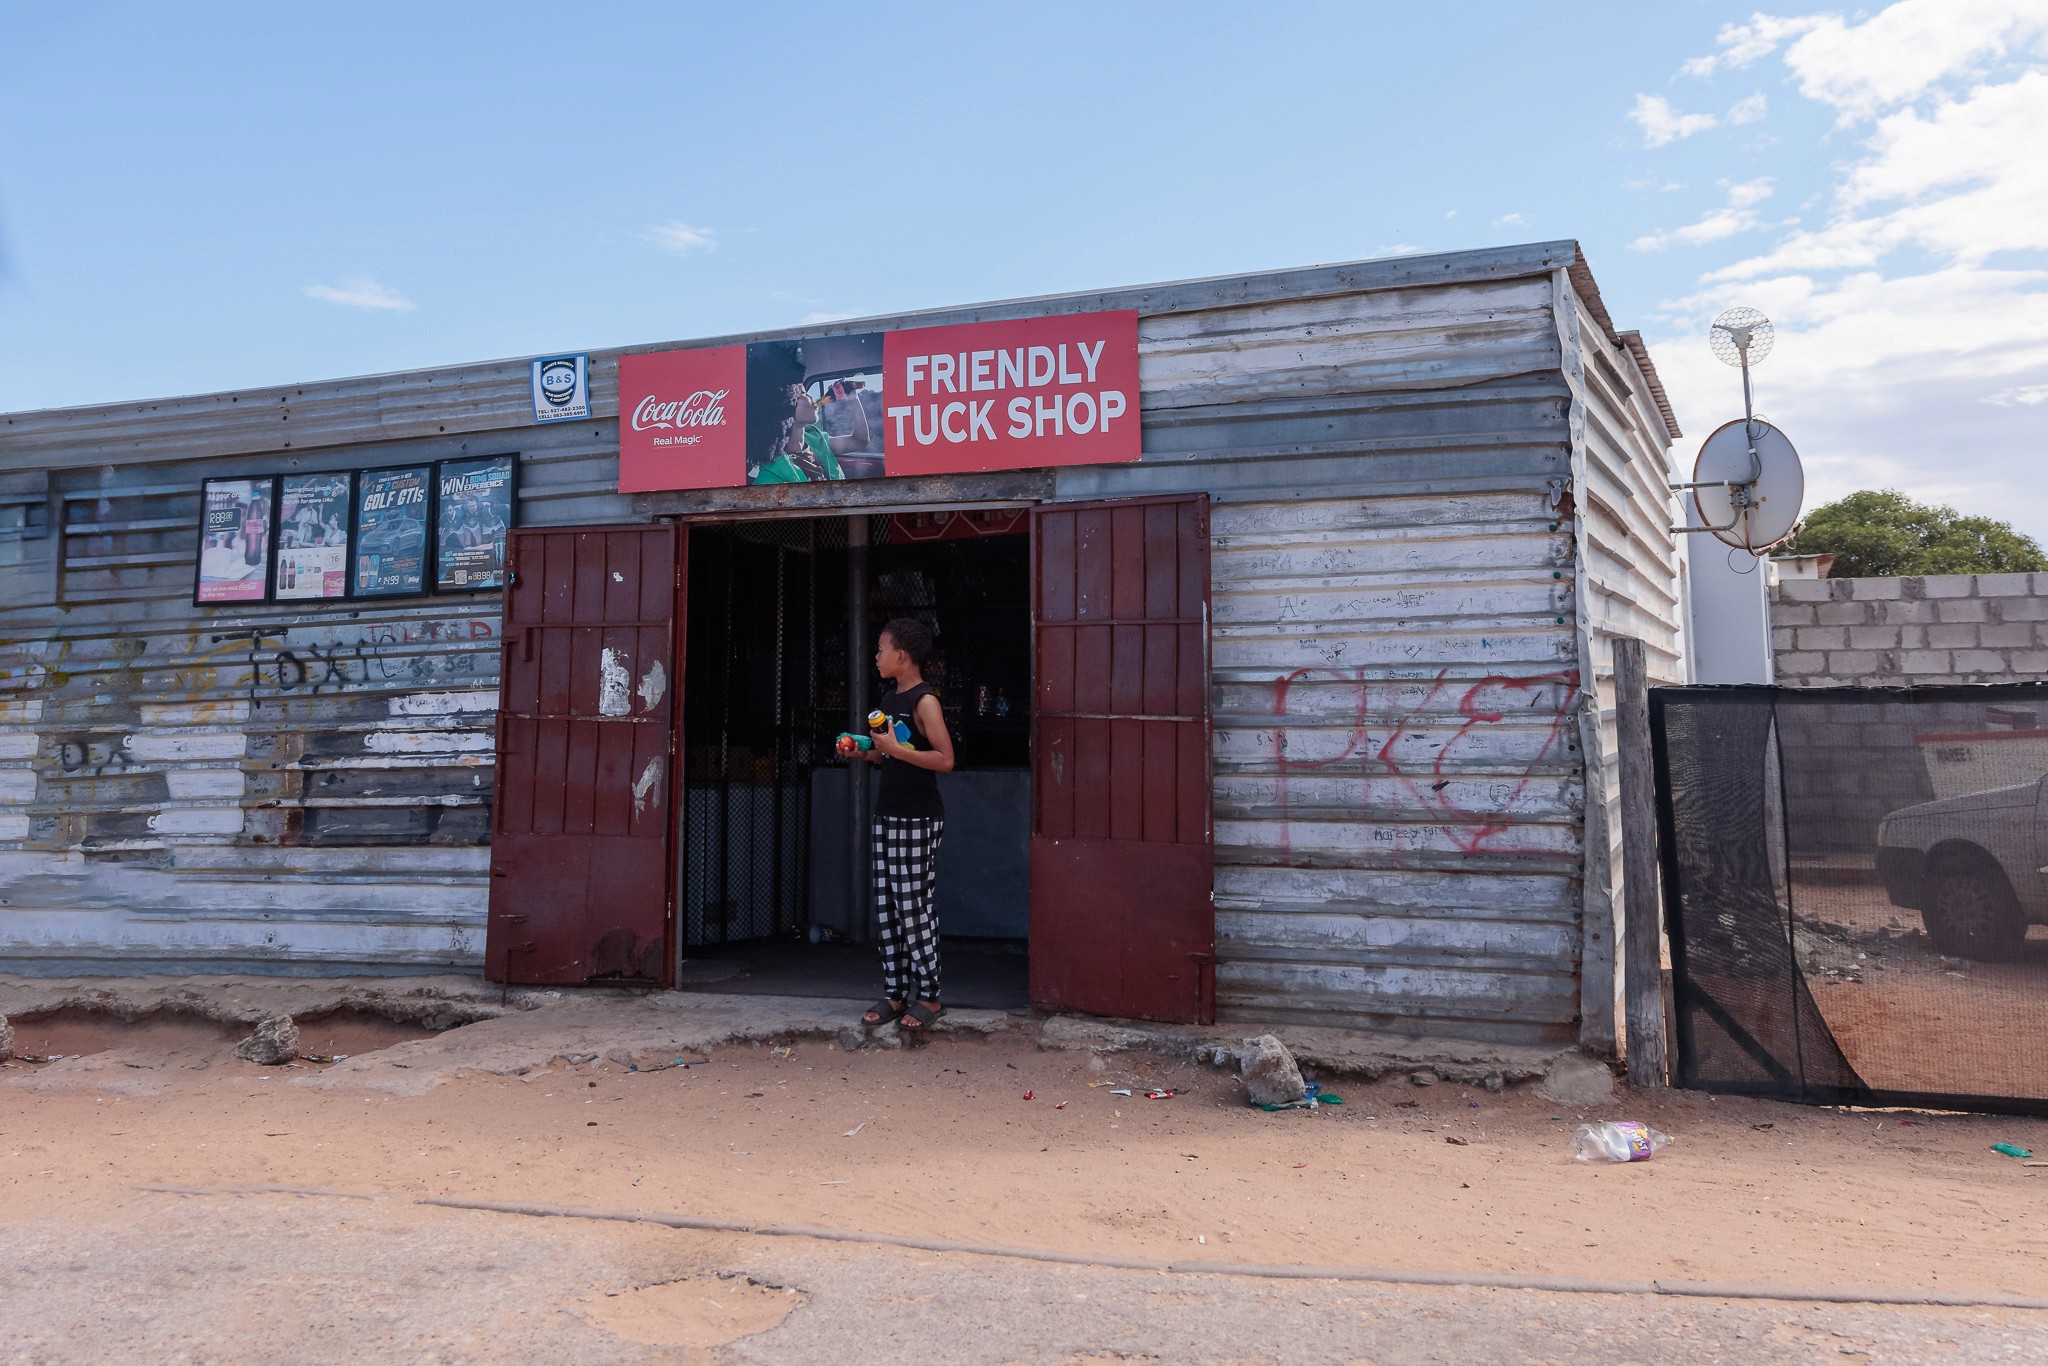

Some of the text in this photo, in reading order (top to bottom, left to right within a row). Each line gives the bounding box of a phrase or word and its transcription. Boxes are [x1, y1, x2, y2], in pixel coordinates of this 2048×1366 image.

[543, 361, 557, 372] PRIVATE
[906, 340, 1106, 397] FRIENDLY
[546, 374, 572, 386] B & S
[631, 388, 730, 432] Coca-Cola
[888, 390, 1127, 447] TUCK SHOP
[653, 434, 701, 446] Real Magic
[487, 471, 510, 481] SQUAD
[376, 483, 385, 492] OF
[384, 481, 392, 491] 2
[391, 476, 420, 490] CUSTOM
[441, 475, 466, 496] WIN
[464, 479, 504, 491] EXPERIENCE
[215, 492, 231, 502] your
[363, 486, 425, 512] GOLF GTIs
